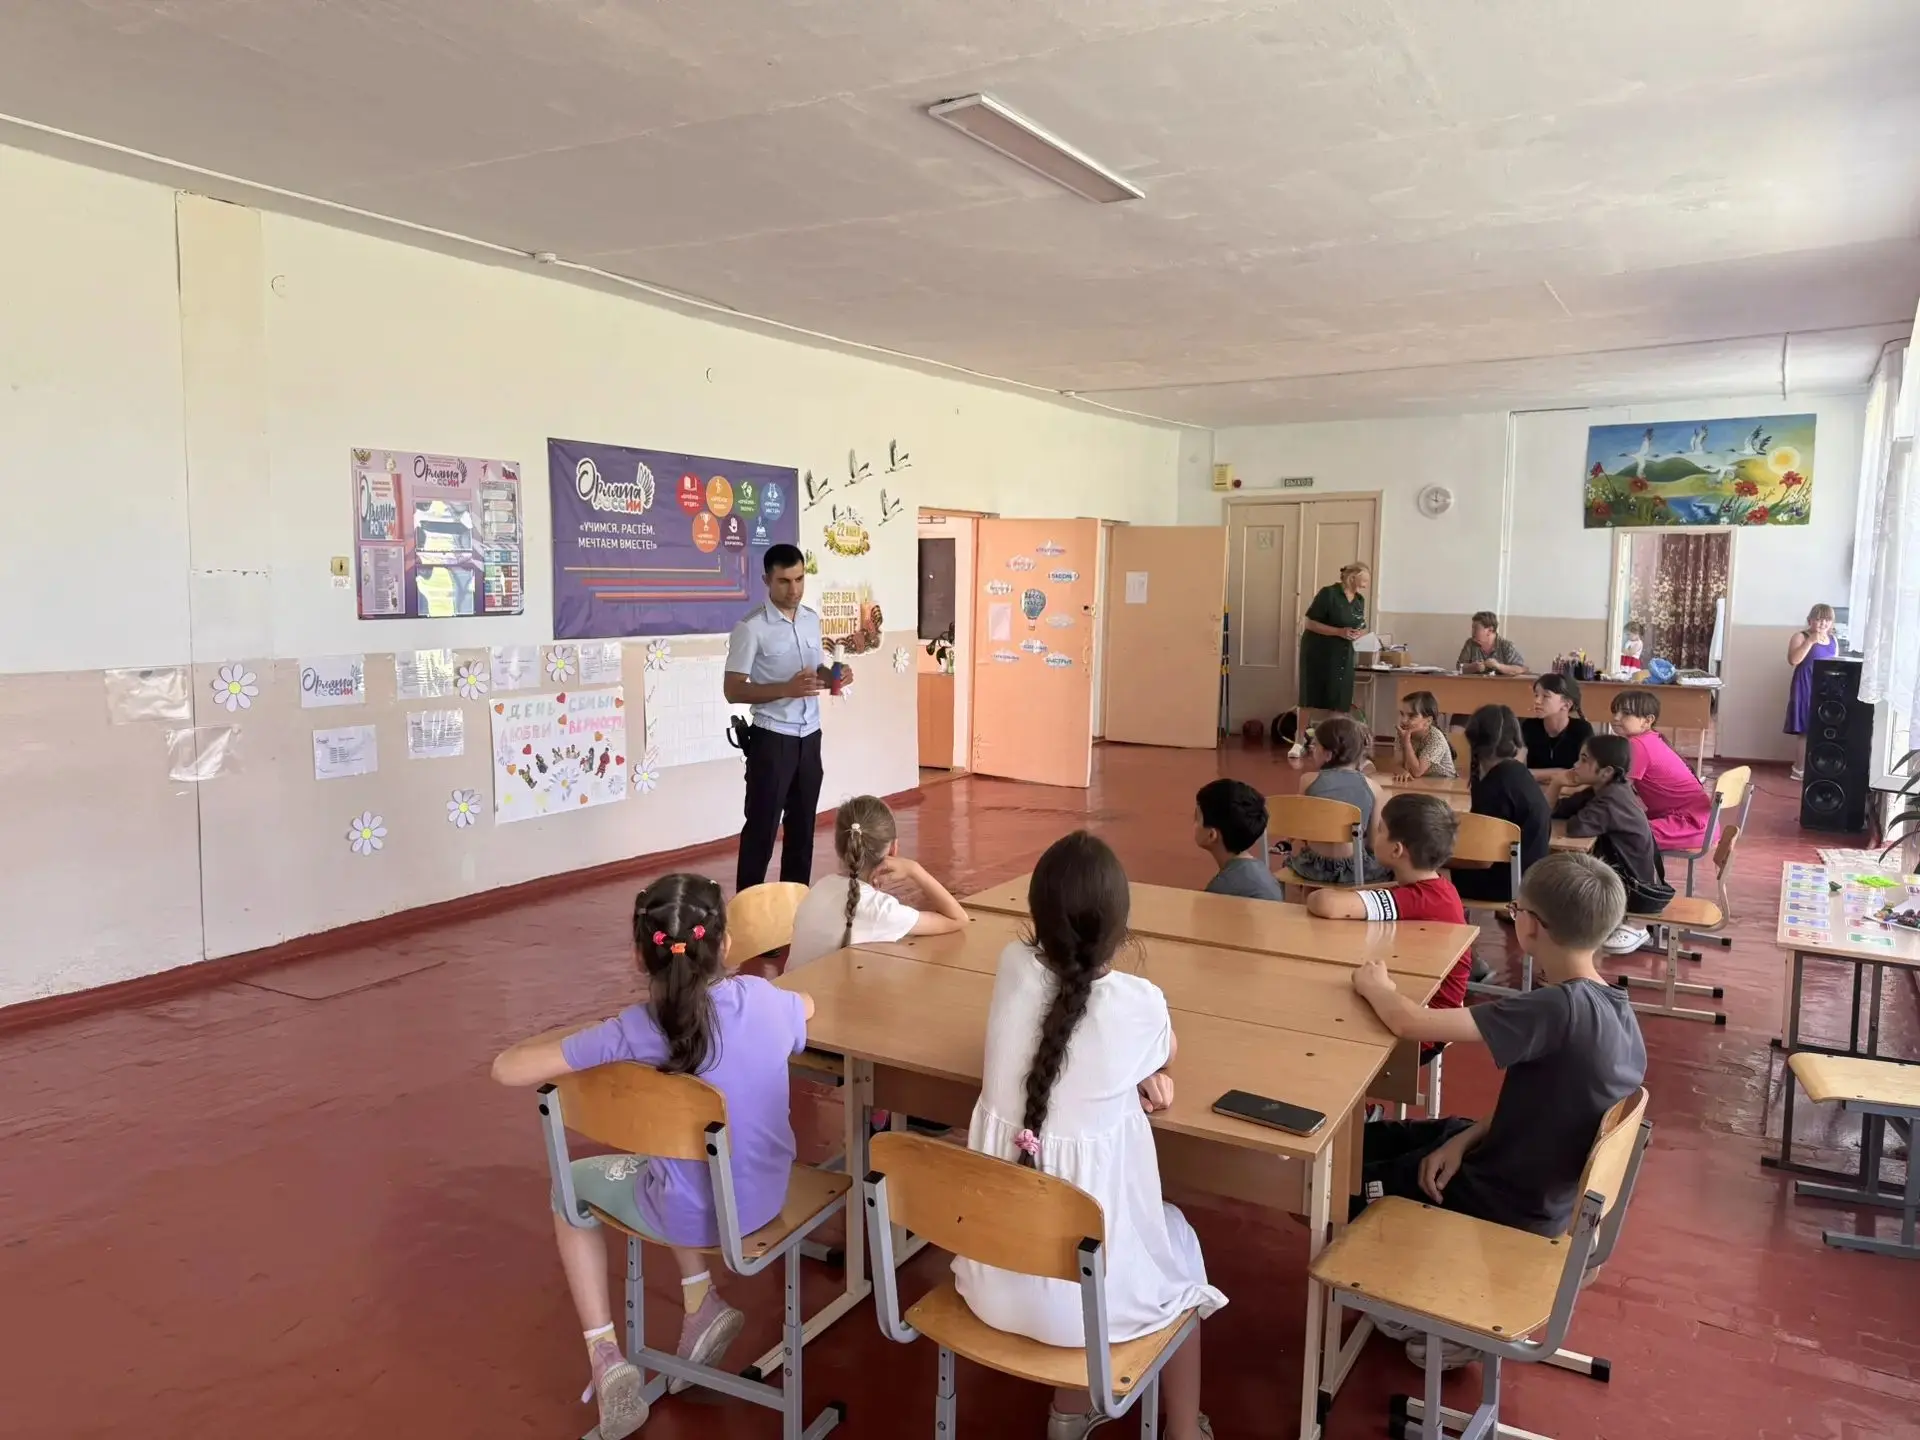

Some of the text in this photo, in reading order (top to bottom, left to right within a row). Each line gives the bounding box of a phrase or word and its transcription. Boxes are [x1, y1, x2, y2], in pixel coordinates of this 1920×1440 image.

[577, 458, 642, 503] Орлята
[578, 537, 618, 549] МЕЧТАЕМ
[822, 605, 840, 616] ЧЕРЕЗ
[301, 667, 353, 695] Орлята
[506, 701, 556, 722] ДЕНЬ
